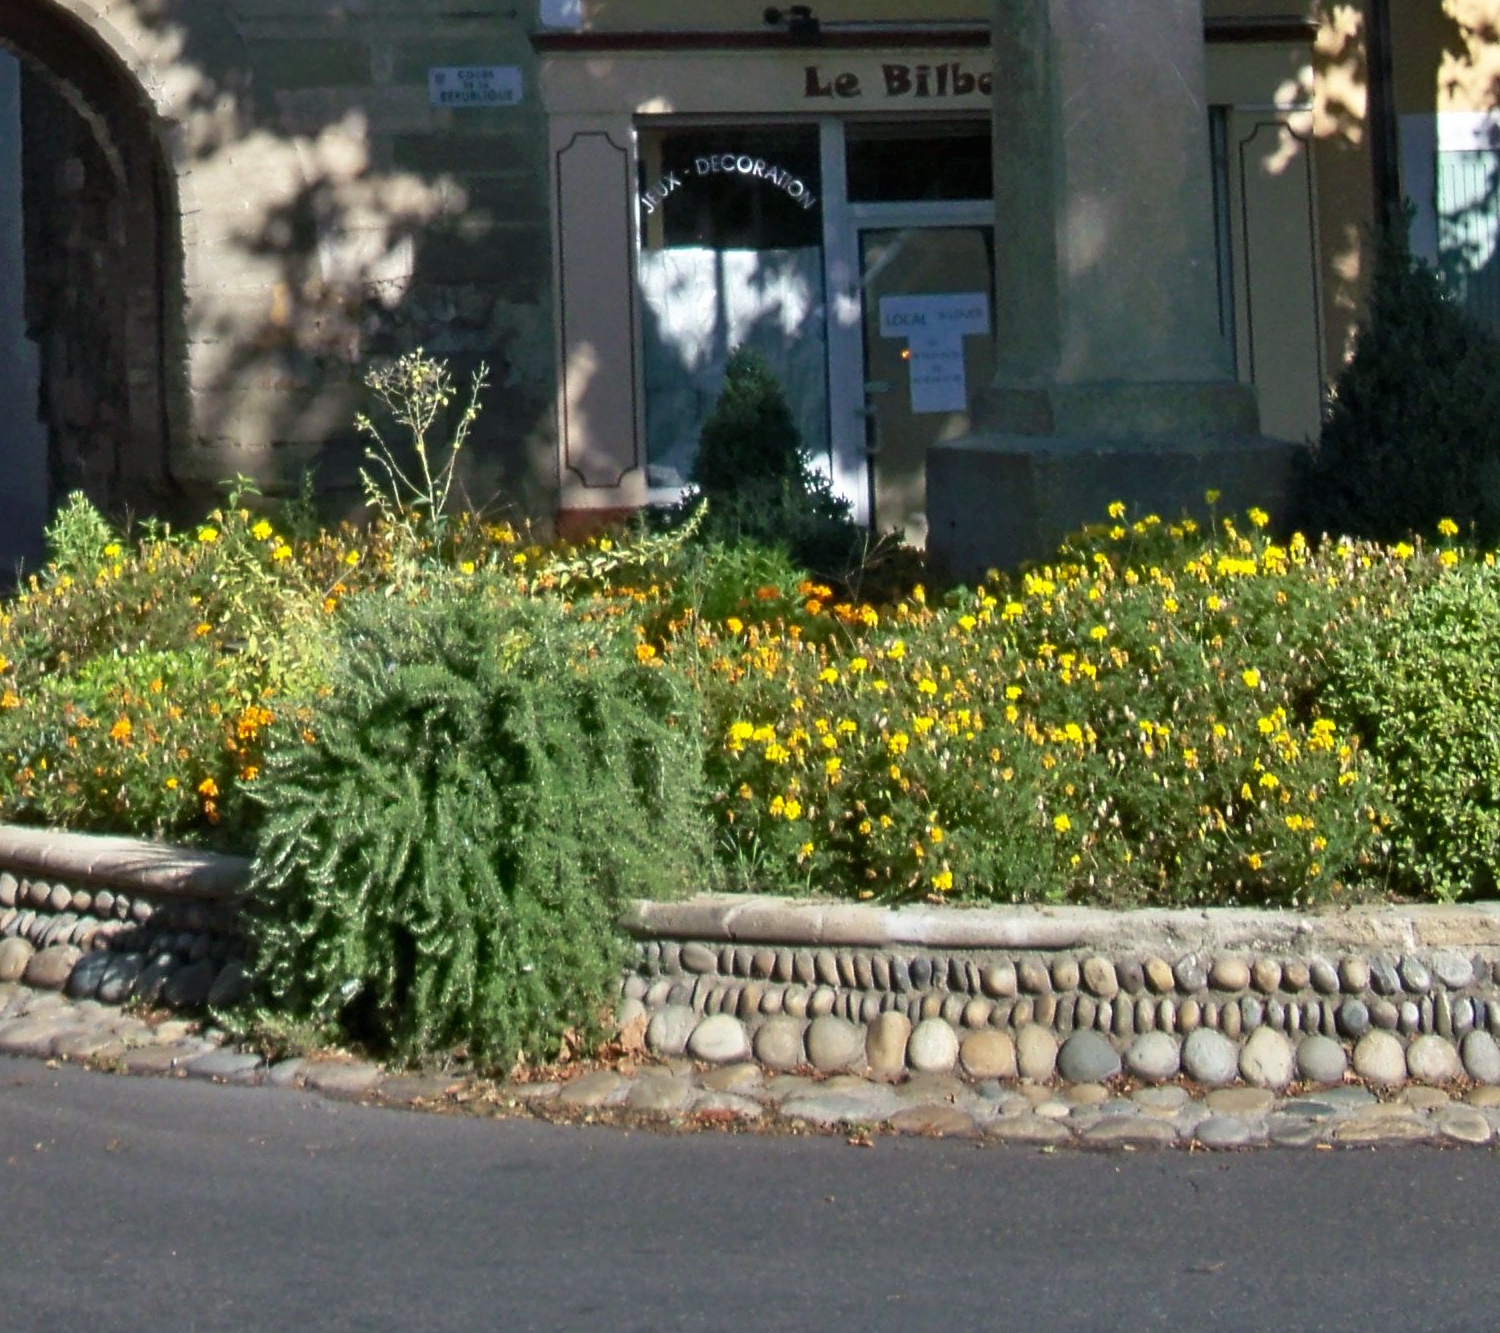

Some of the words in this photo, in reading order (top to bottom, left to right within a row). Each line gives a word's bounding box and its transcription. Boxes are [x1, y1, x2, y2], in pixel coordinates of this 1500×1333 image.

[804, 65, 861, 98] Le
[641, 171, 682, 214] JEUX
[886, 314, 926, 326] LOCAL
